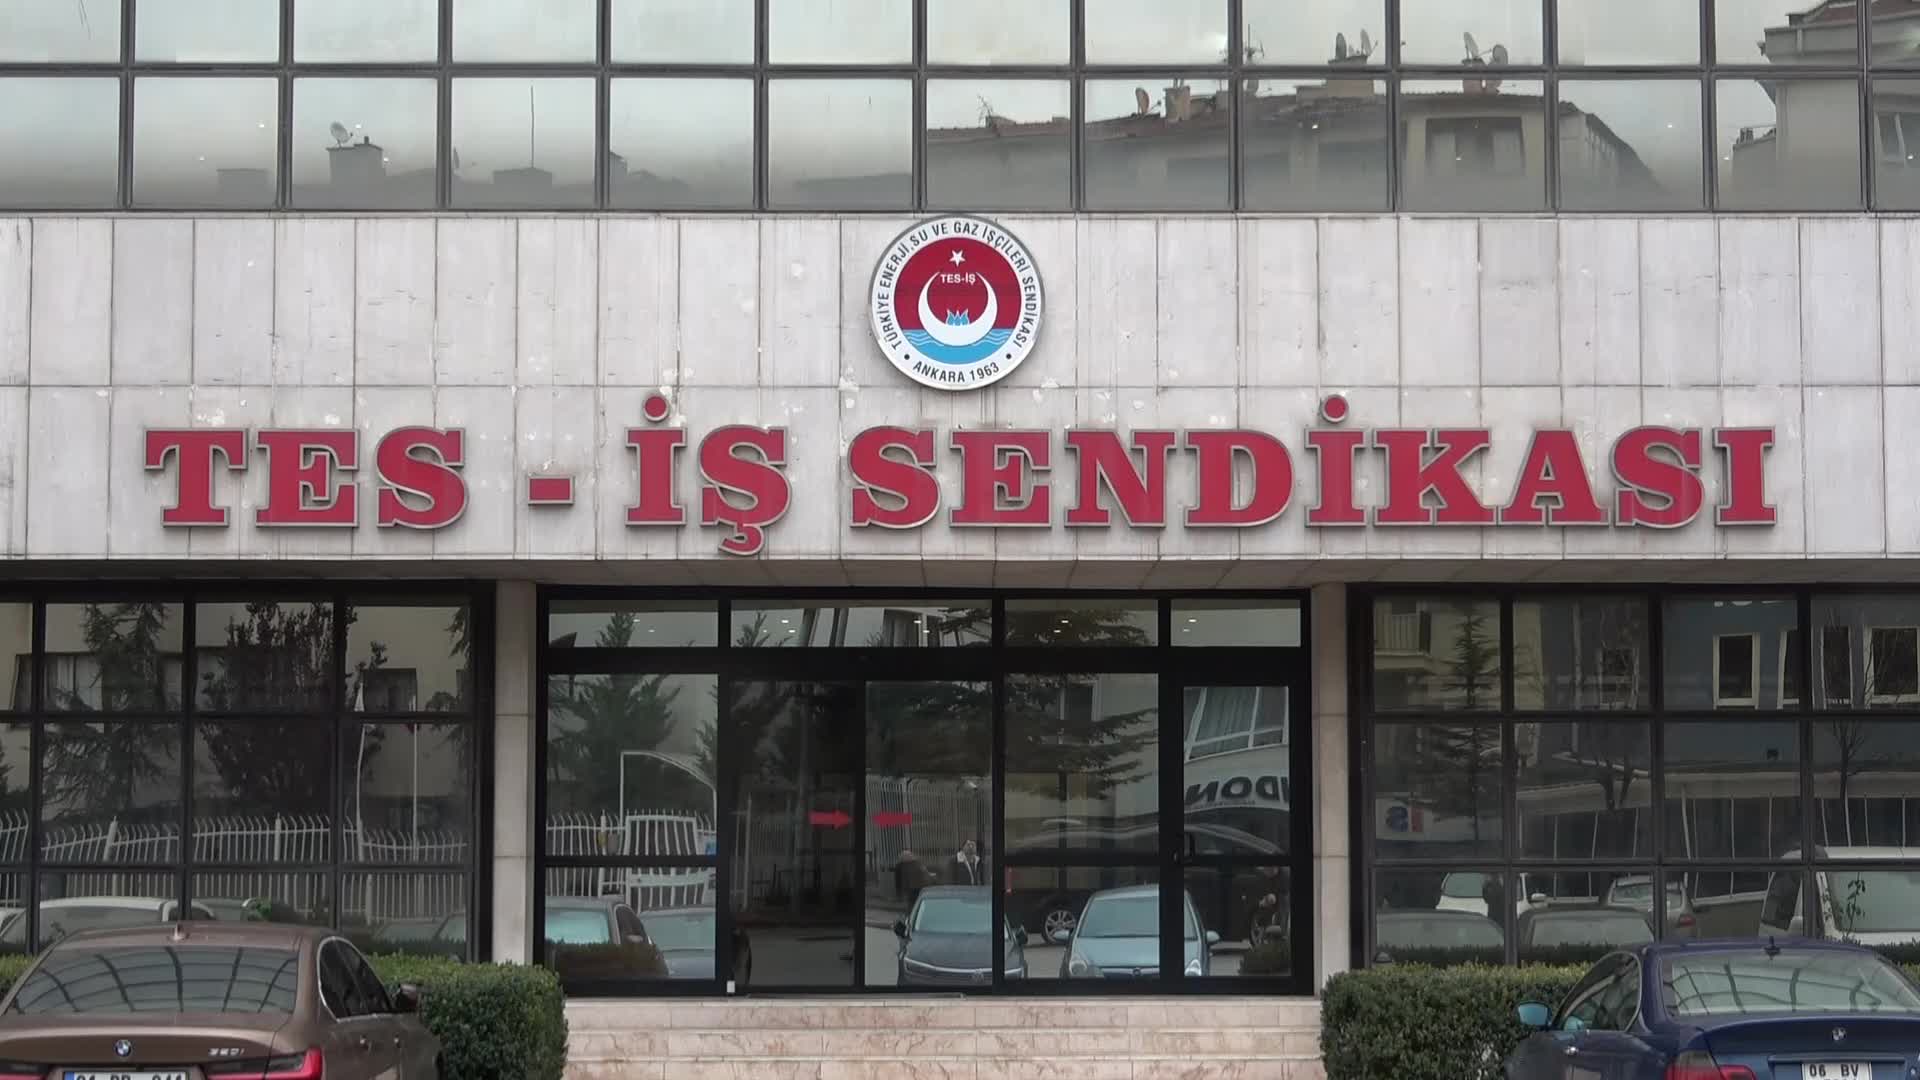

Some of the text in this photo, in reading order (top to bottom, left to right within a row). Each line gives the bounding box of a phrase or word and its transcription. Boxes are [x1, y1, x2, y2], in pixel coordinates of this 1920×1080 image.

[876, 293, 902, 350] TÜRKİYE
[932, 222, 949, 237] VE
[954, 221, 979, 236] GAZ
[982, 225, 1031, 273] İŞÇİLERİ
[1013, 276, 1038, 349] SENDİKASI
[940, 272, 976, 286] TES-İŞ
[912, 361, 1000, 383] ANKARA 1963
[144, 425, 467, 529] TES
[625, 395, 791, 556] İŞ
[847, 394, 1777, 529] SENDİKASI
[1809, 1063, 1859, 1077] 06 BV
